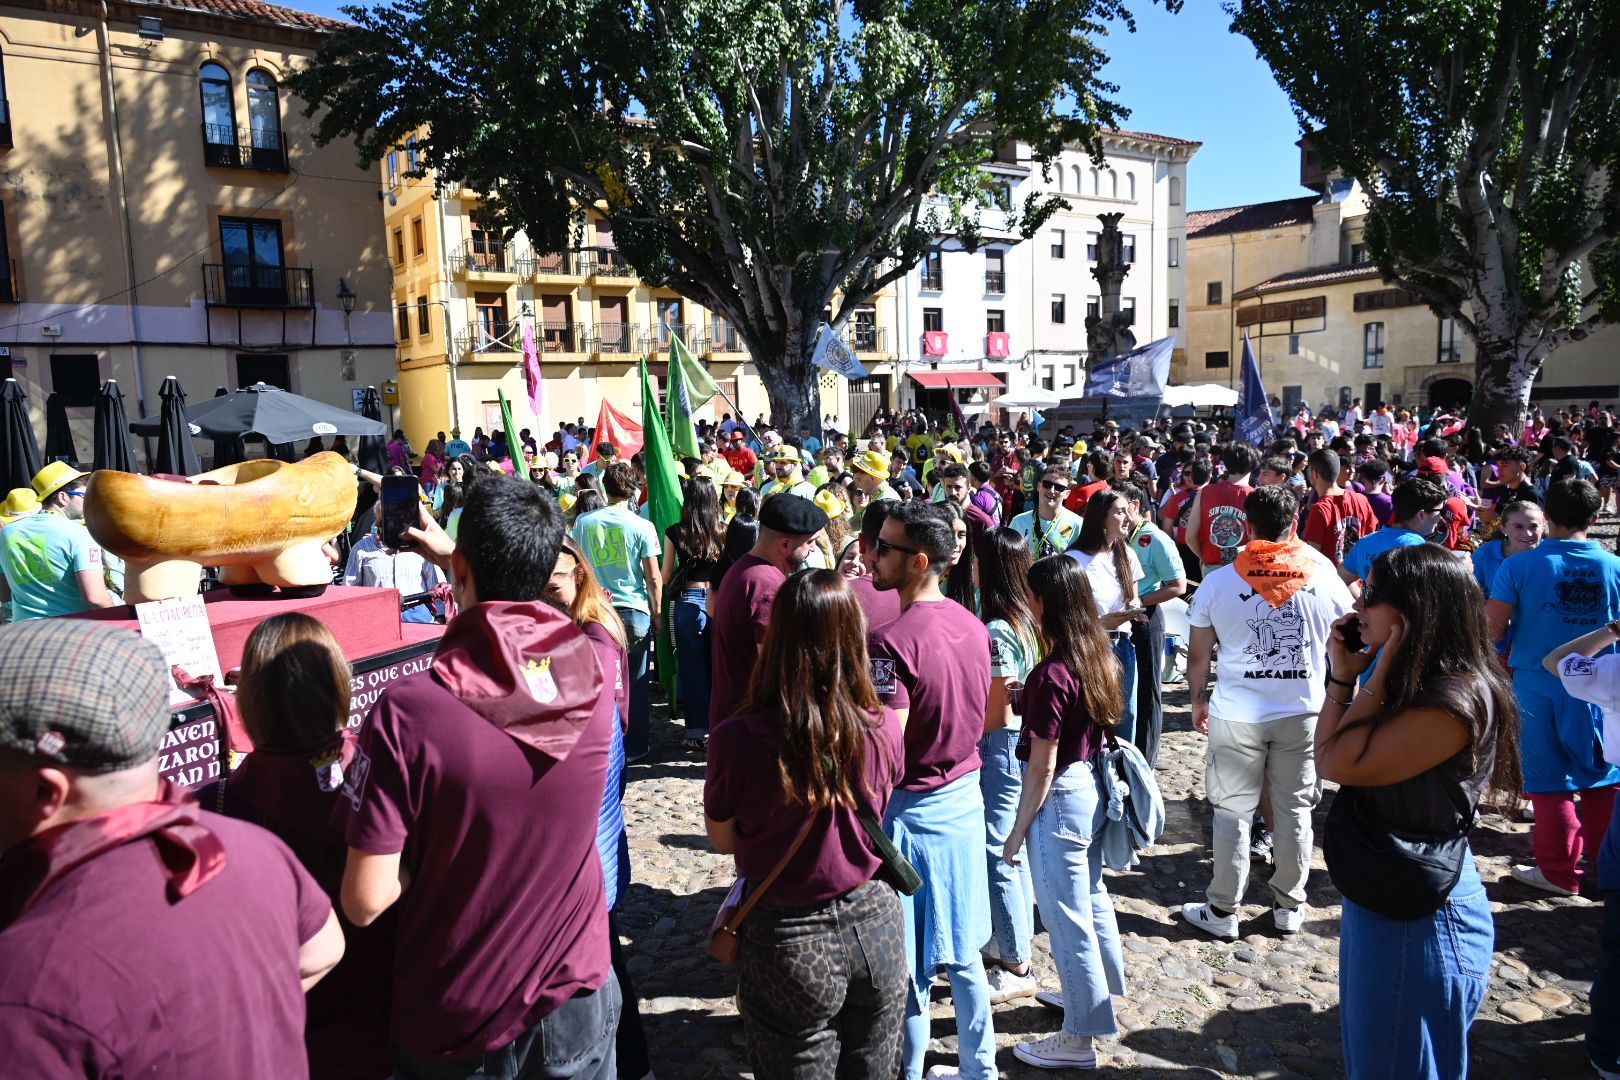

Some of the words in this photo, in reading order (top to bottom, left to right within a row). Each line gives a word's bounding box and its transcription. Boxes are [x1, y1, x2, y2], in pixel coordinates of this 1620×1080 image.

[1209, 506, 1220, 517] SIN
[1220, 505, 1247, 521] CONTRO
[1247, 569, 1304, 579] MECANICA
[368, 666, 400, 688] QUE
[402, 656, 433, 676] CALZ
